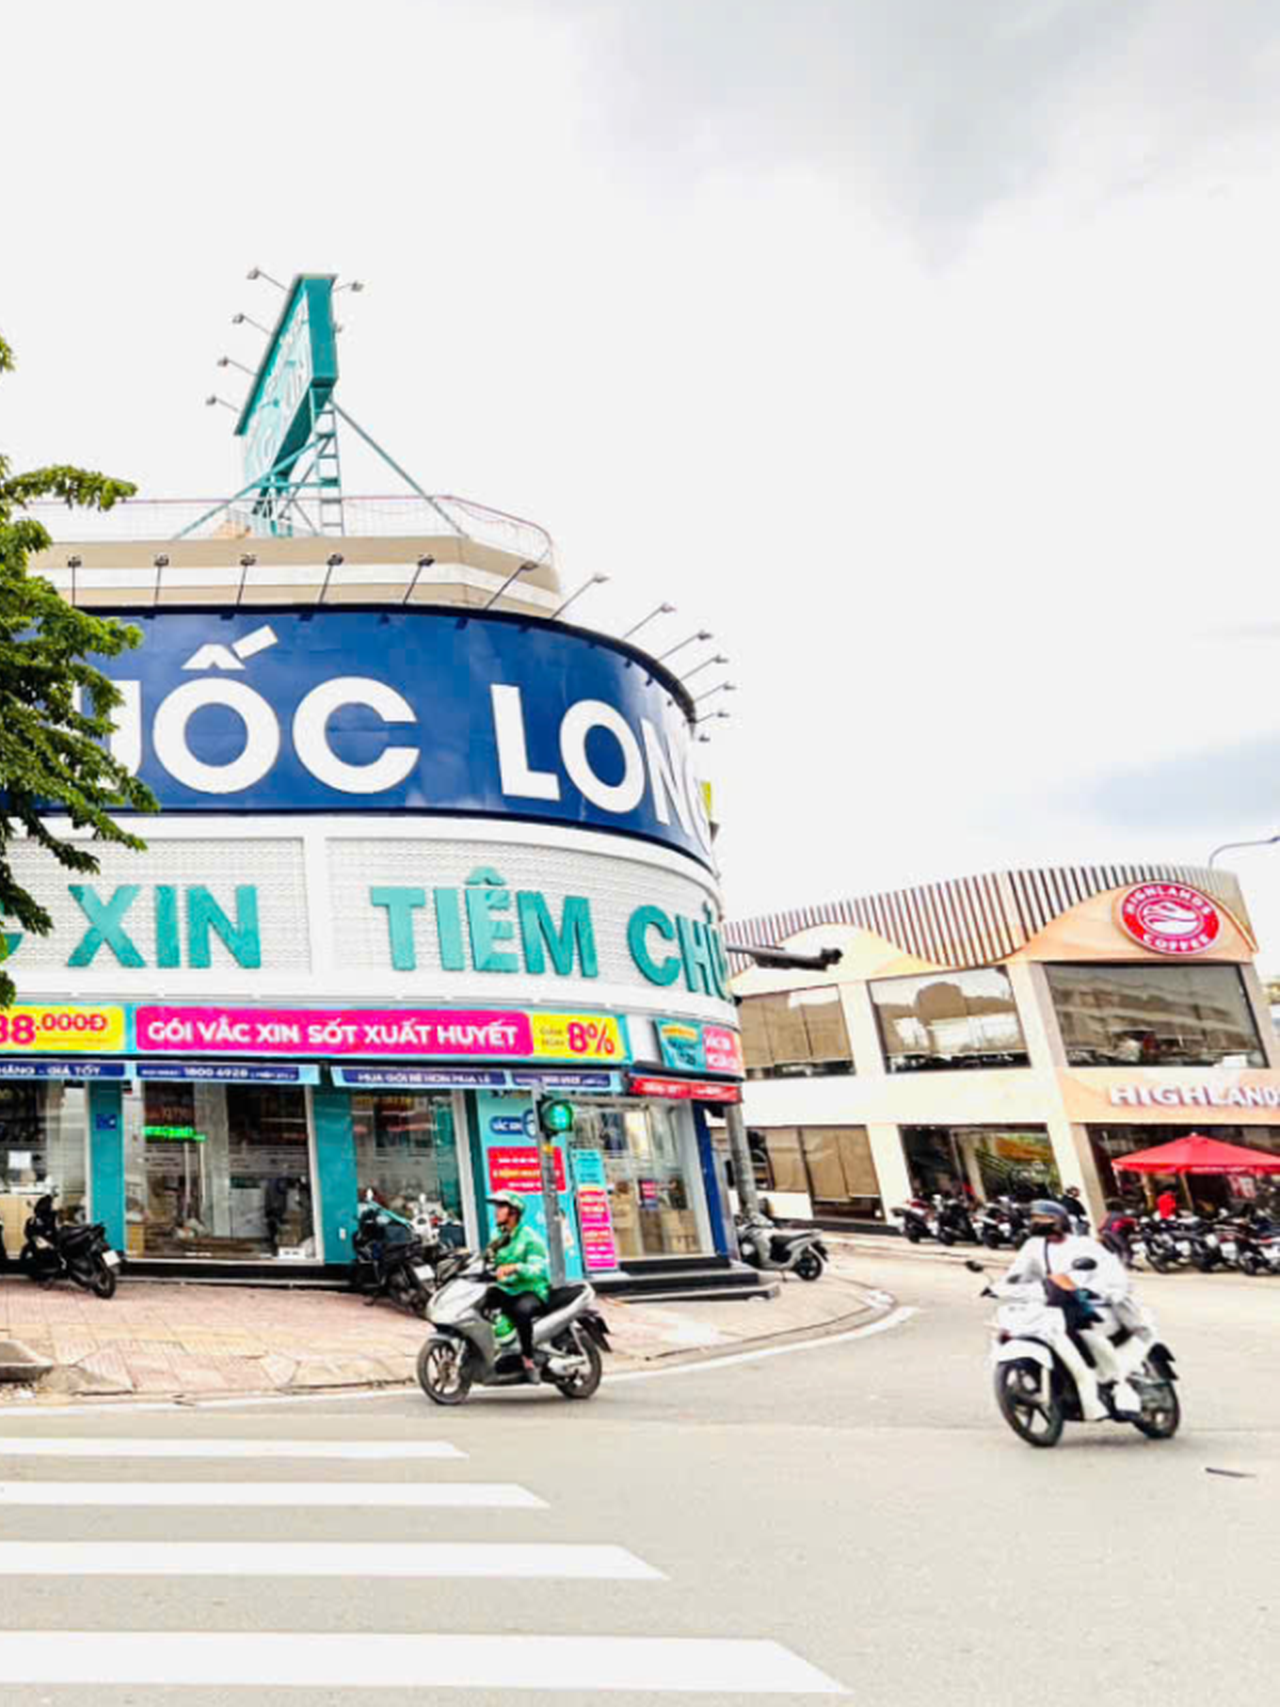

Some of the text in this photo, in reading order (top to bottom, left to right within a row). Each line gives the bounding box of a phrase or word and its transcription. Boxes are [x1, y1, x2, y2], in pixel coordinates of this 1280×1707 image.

[51, 624, 709, 856] UỐC LON
[67, 884, 262, 968] XIN
[370, 866, 598, 978] TIÊM
[148, 1015, 519, 1046] GÓI VẮC XIN SỐT XUẤT HUYẾT
[568, 1020, 615, 1055] 8%
[183, 1066, 213, 1077] 1800
[216, 1067, 248, 1078] 6928
